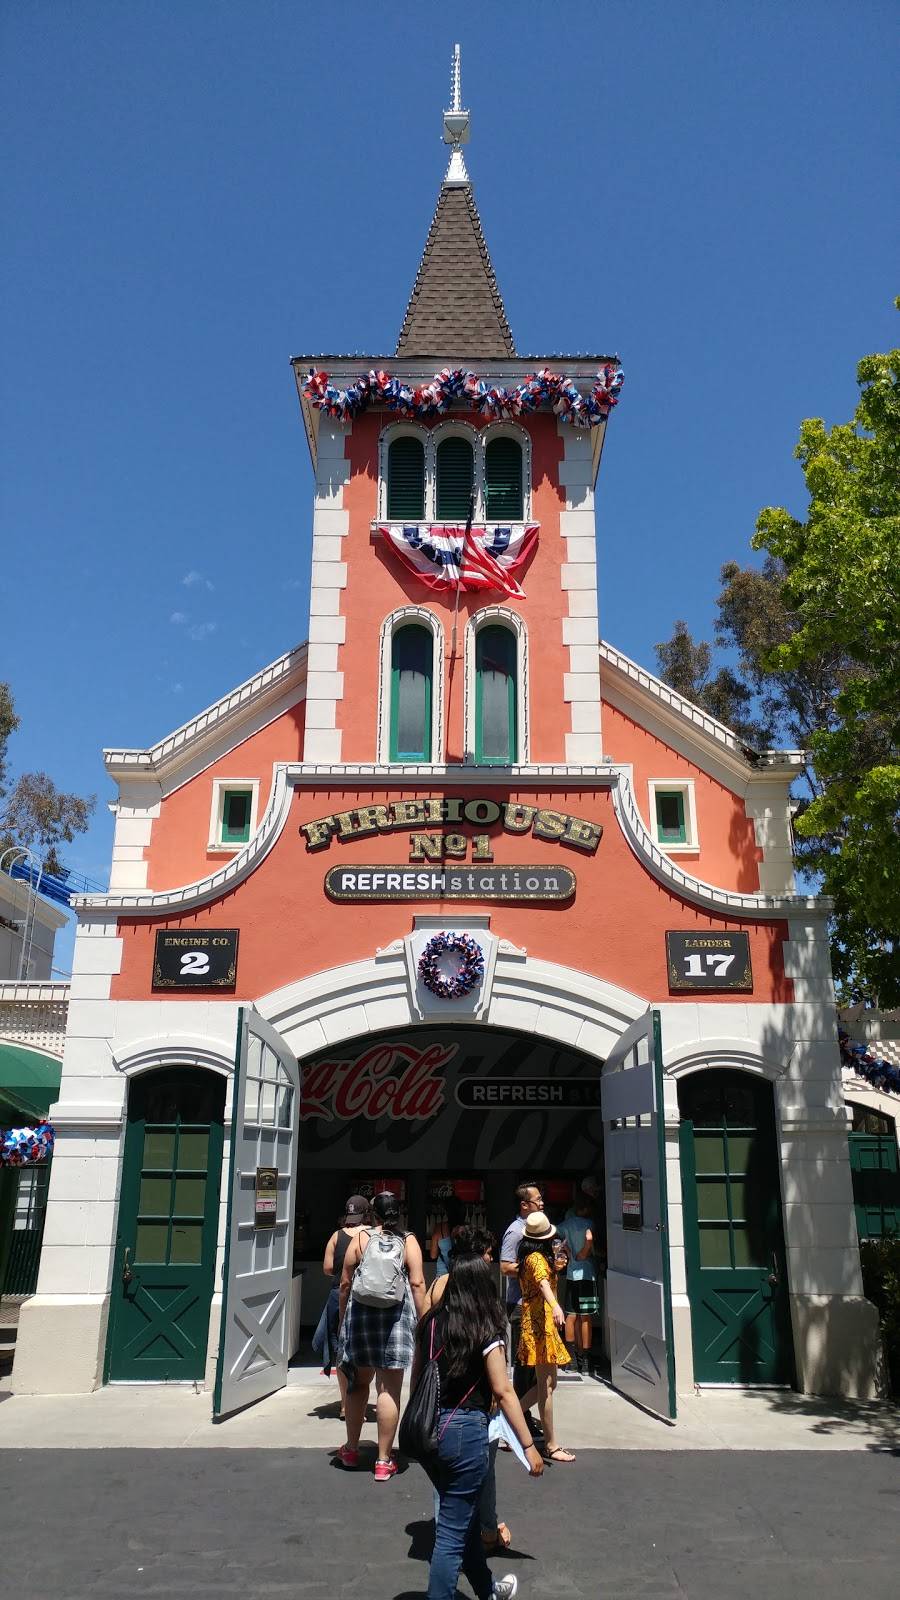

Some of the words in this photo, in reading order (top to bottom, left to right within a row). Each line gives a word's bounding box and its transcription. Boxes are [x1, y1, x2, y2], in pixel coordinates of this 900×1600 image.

[300, 799, 604, 856] FIREHOUSE
[341, 873, 446, 891] REFRESH
[449, 872, 560, 891] station
[164, 938, 209, 946] ENGINE
[212, 938, 231, 946] CO.
[684, 939, 732, 948] LADDER
[179, 951, 210, 975] 2
[683, 954, 736, 977] 17
[472, 1084, 563, 1101] REFRESH
